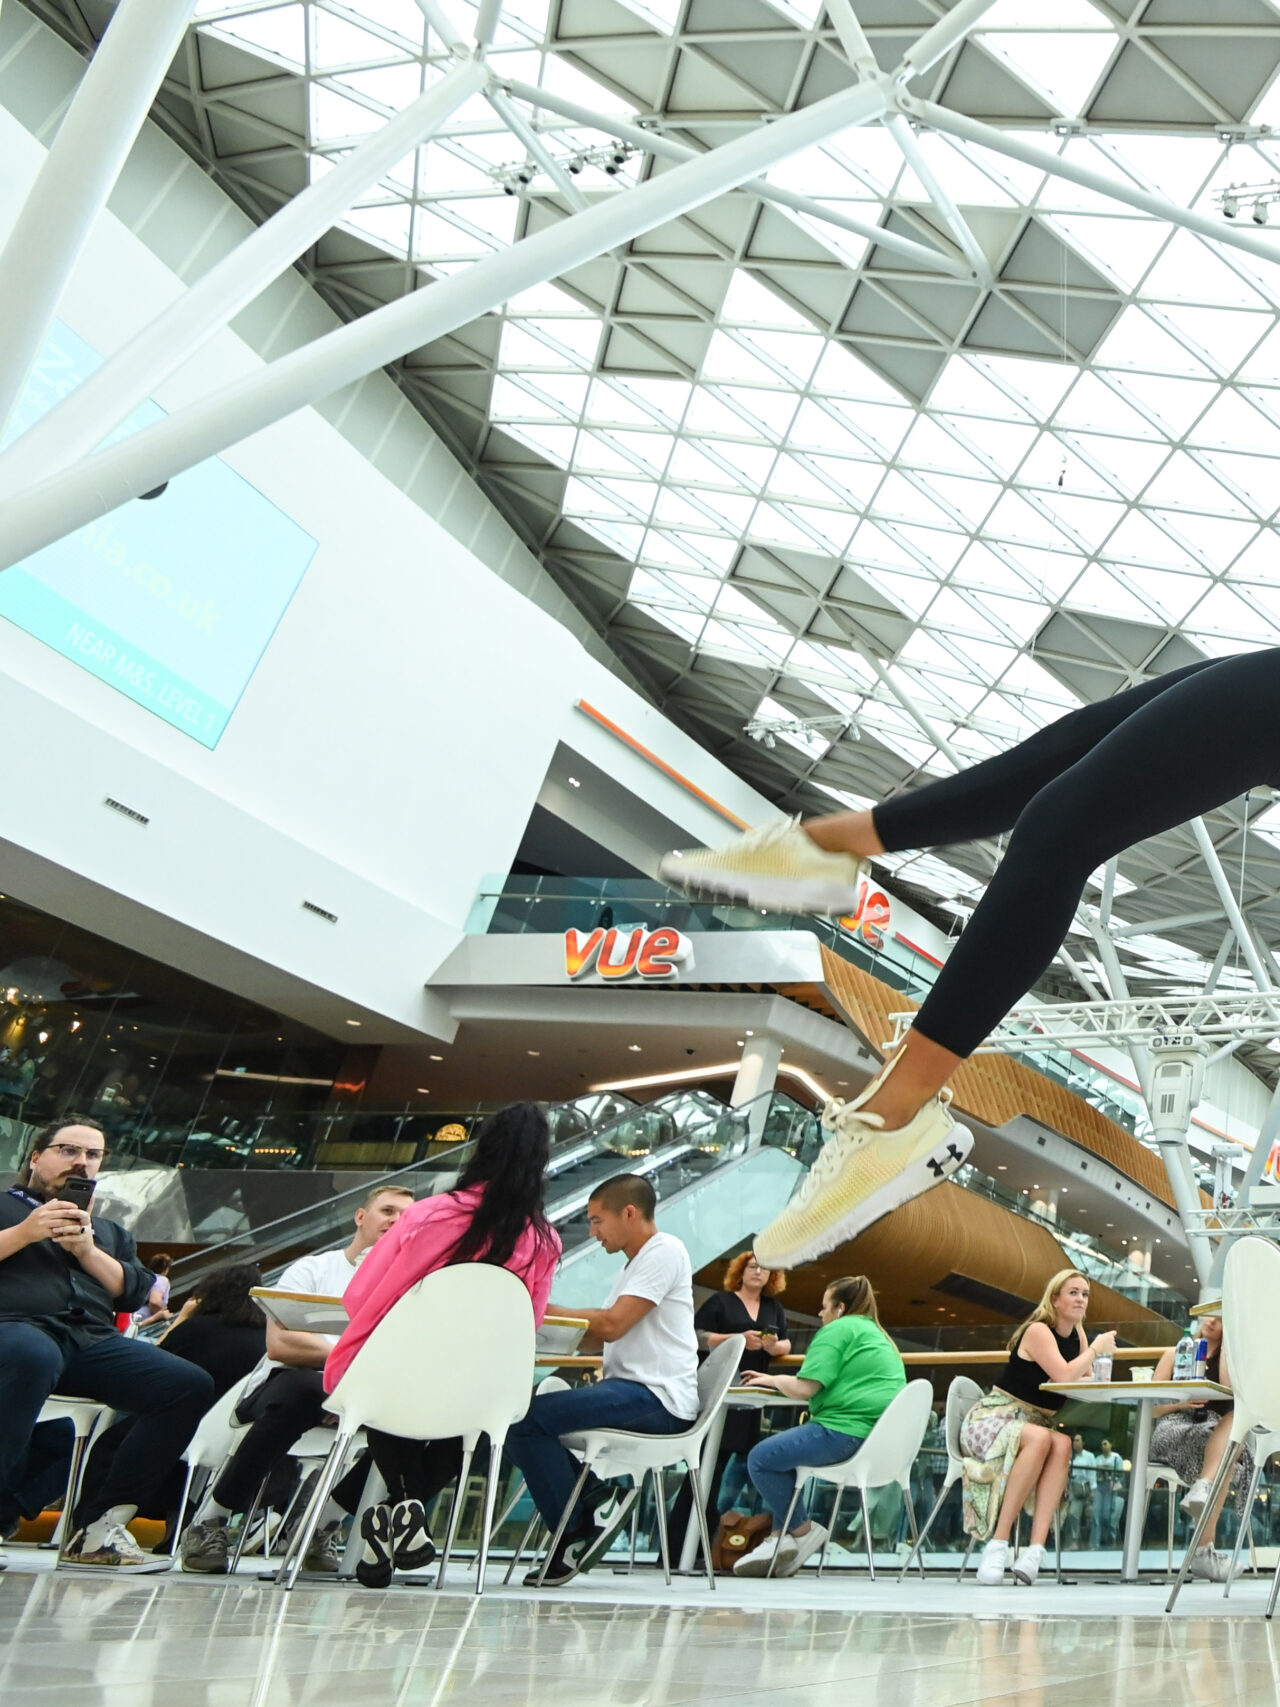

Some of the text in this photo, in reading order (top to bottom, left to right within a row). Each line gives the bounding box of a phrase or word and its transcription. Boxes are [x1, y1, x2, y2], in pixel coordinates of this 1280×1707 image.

[65, 622, 216, 732] NEAR M&S, LEVEL 1
